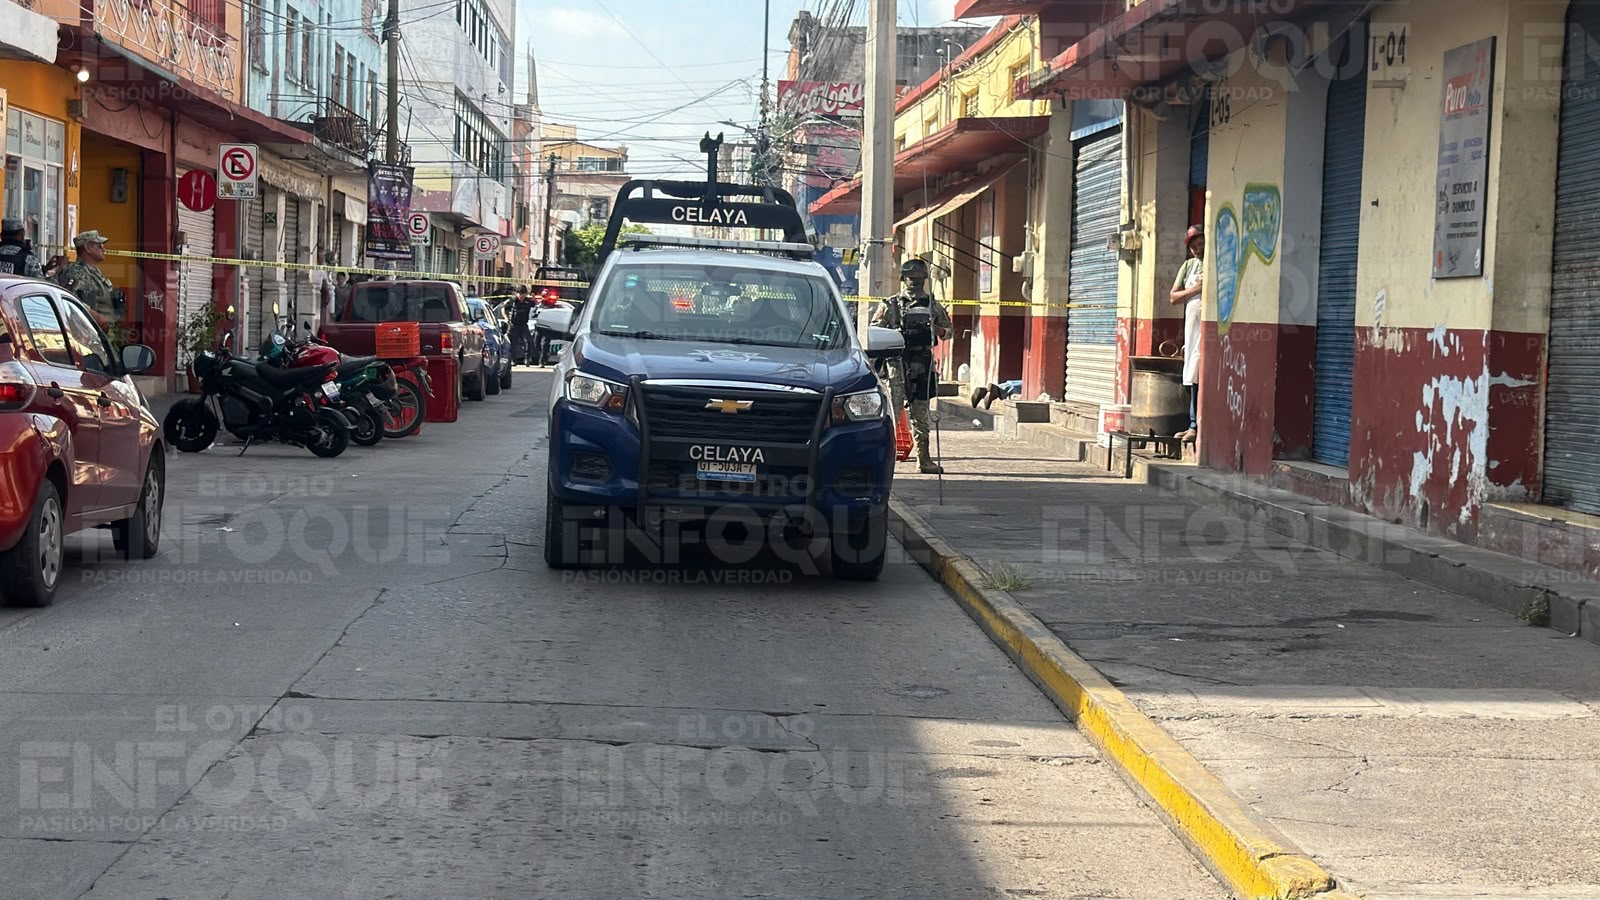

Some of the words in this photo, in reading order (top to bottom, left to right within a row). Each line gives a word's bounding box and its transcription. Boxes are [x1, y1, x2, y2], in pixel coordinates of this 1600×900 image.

[1371, 28, 1406, 71] L-04
[1445, 83, 1466, 112] Puro
[414, 218, 423, 230] E
[672, 206, 748, 225] CELAYA
[480, 240, 487, 250] E
[689, 445, 764, 463] CELAYA
